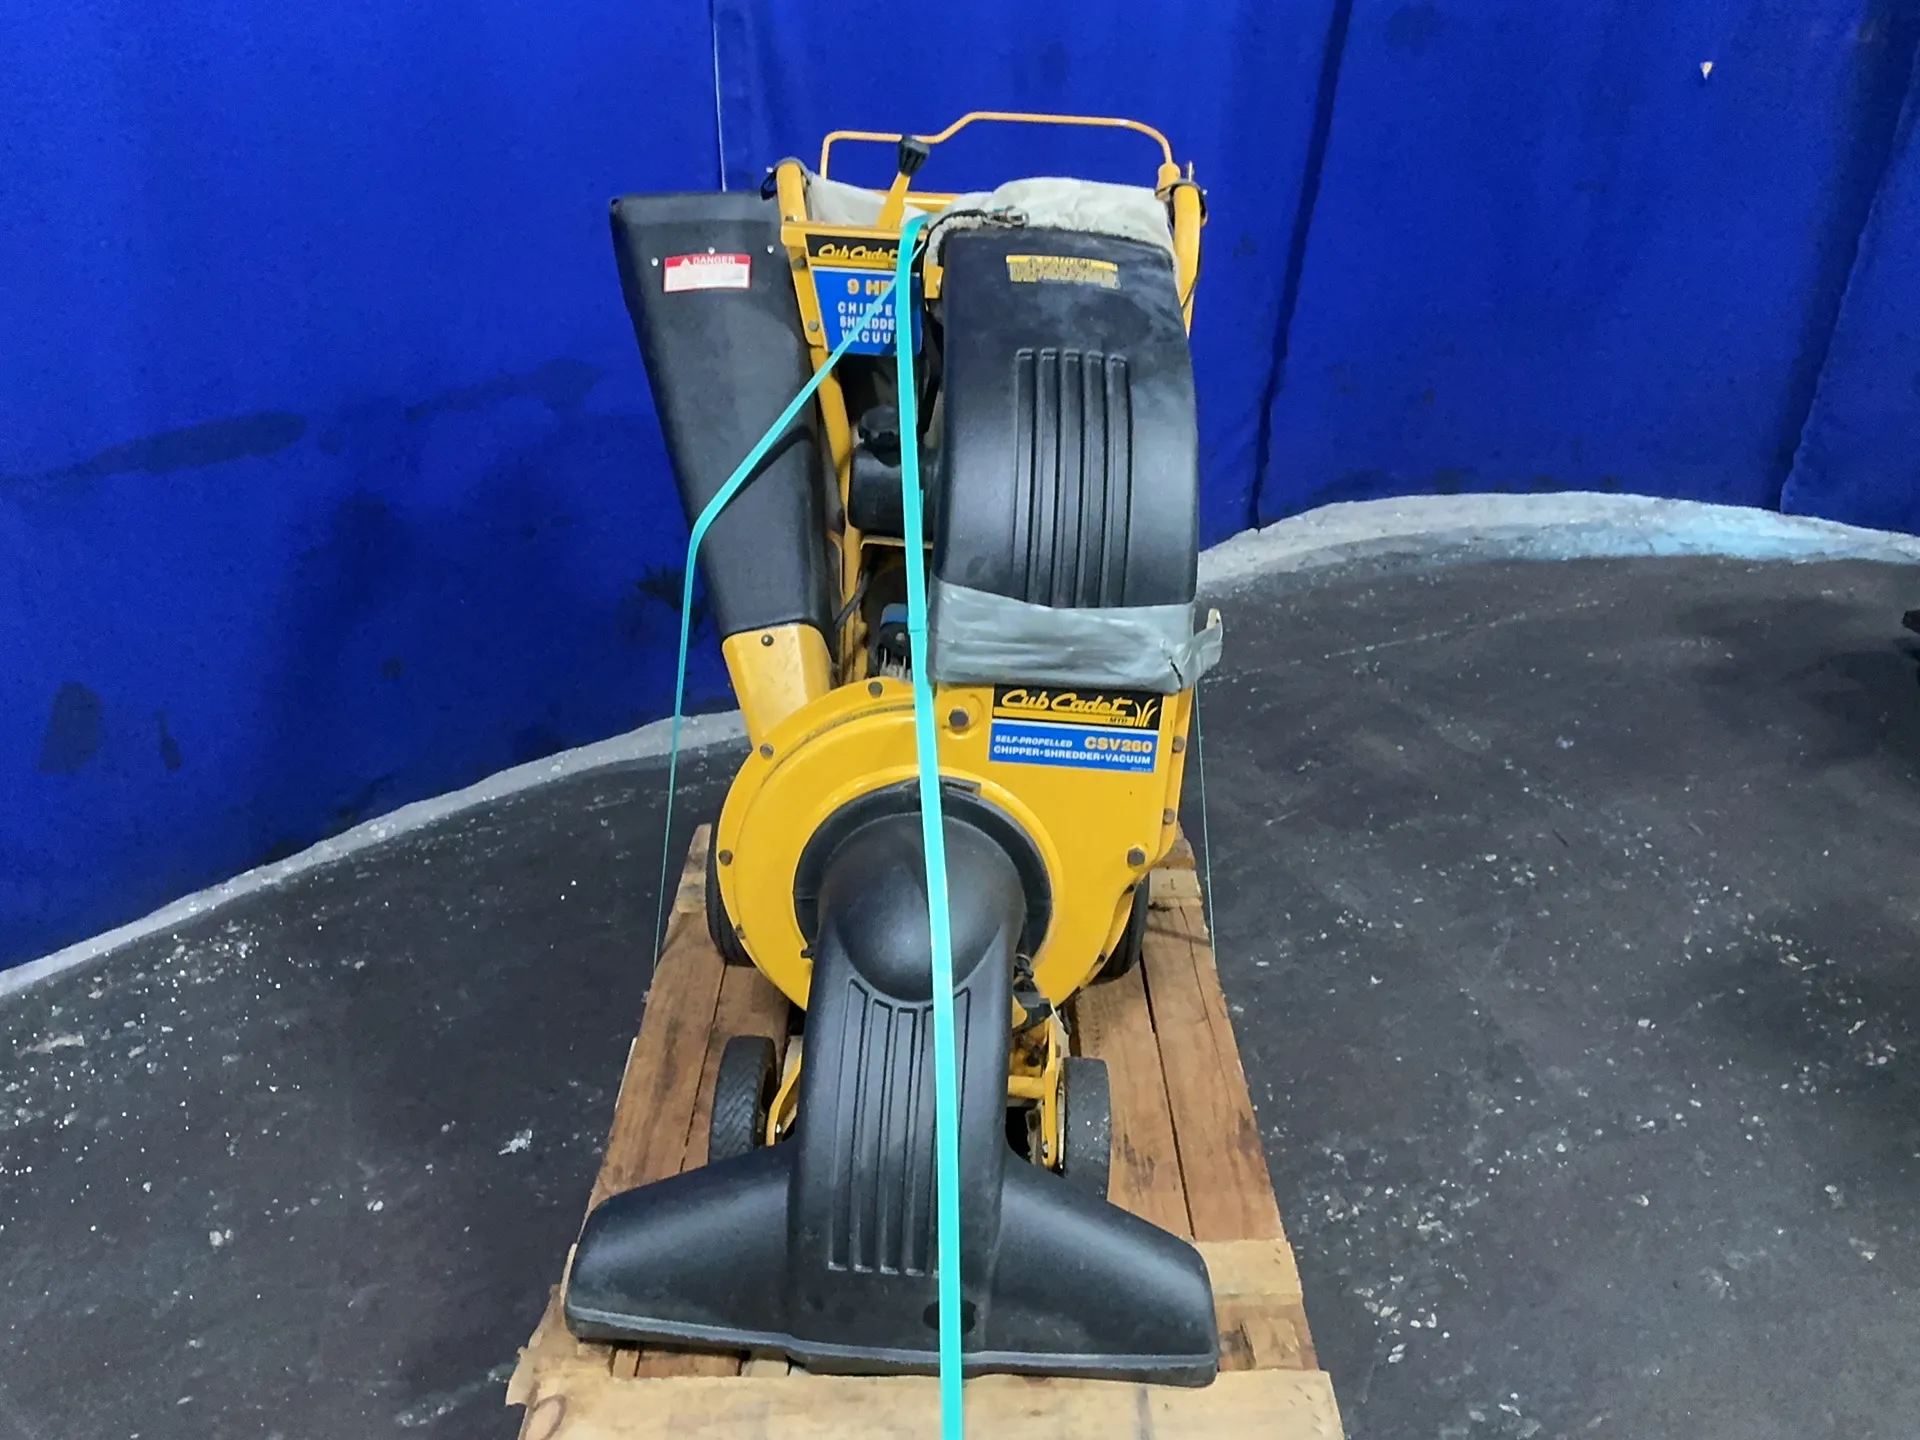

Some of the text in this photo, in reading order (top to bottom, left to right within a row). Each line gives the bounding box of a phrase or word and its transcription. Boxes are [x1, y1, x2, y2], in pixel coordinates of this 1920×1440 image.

[818, 243, 849, 258] Cub
[692, 255, 736, 265] DANGER
[847, 278, 859, 295] 9
[1001, 689, 1132, 715] Cub Cadet
[995, 734, 1073, 748] SELF-PROPELLED
